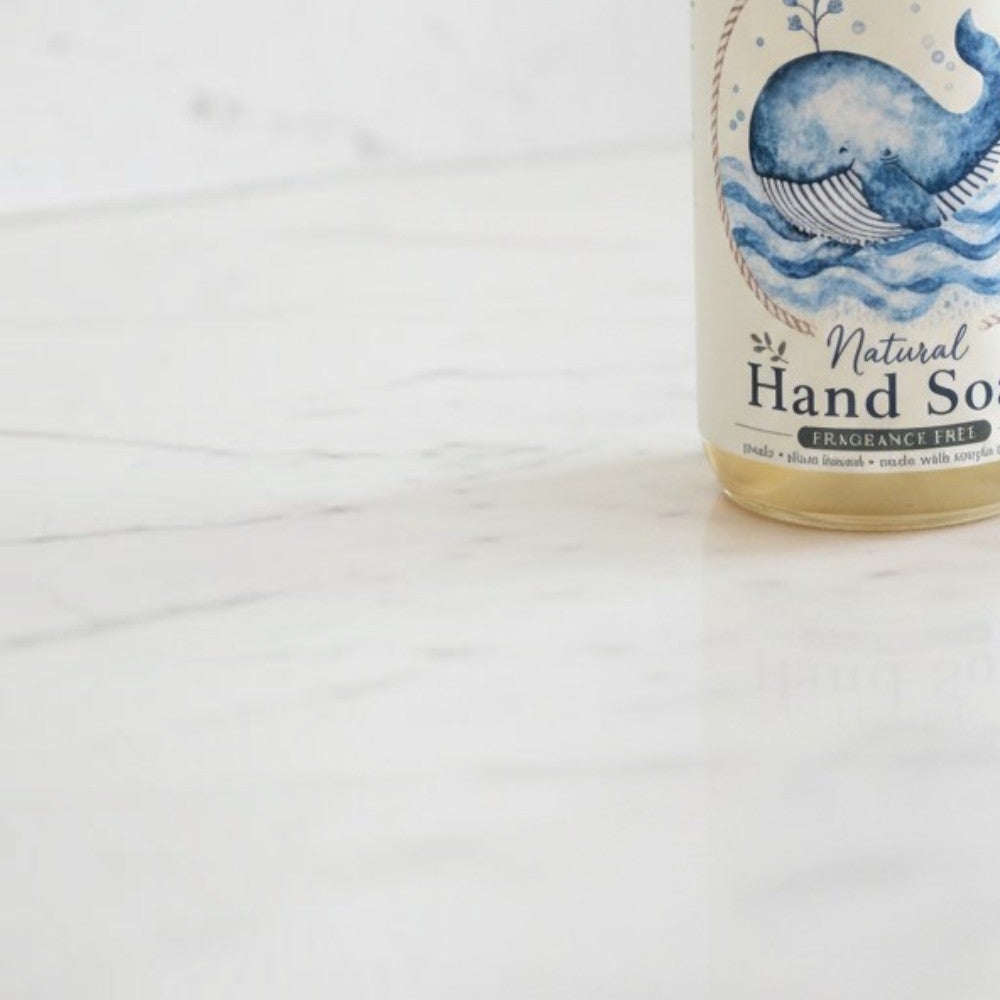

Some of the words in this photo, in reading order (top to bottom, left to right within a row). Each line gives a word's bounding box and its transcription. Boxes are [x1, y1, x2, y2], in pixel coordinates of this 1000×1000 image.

[826, 323, 969, 376] Natural
[747, 360, 900, 419] Hand
[934, 424, 977, 445] FREE
